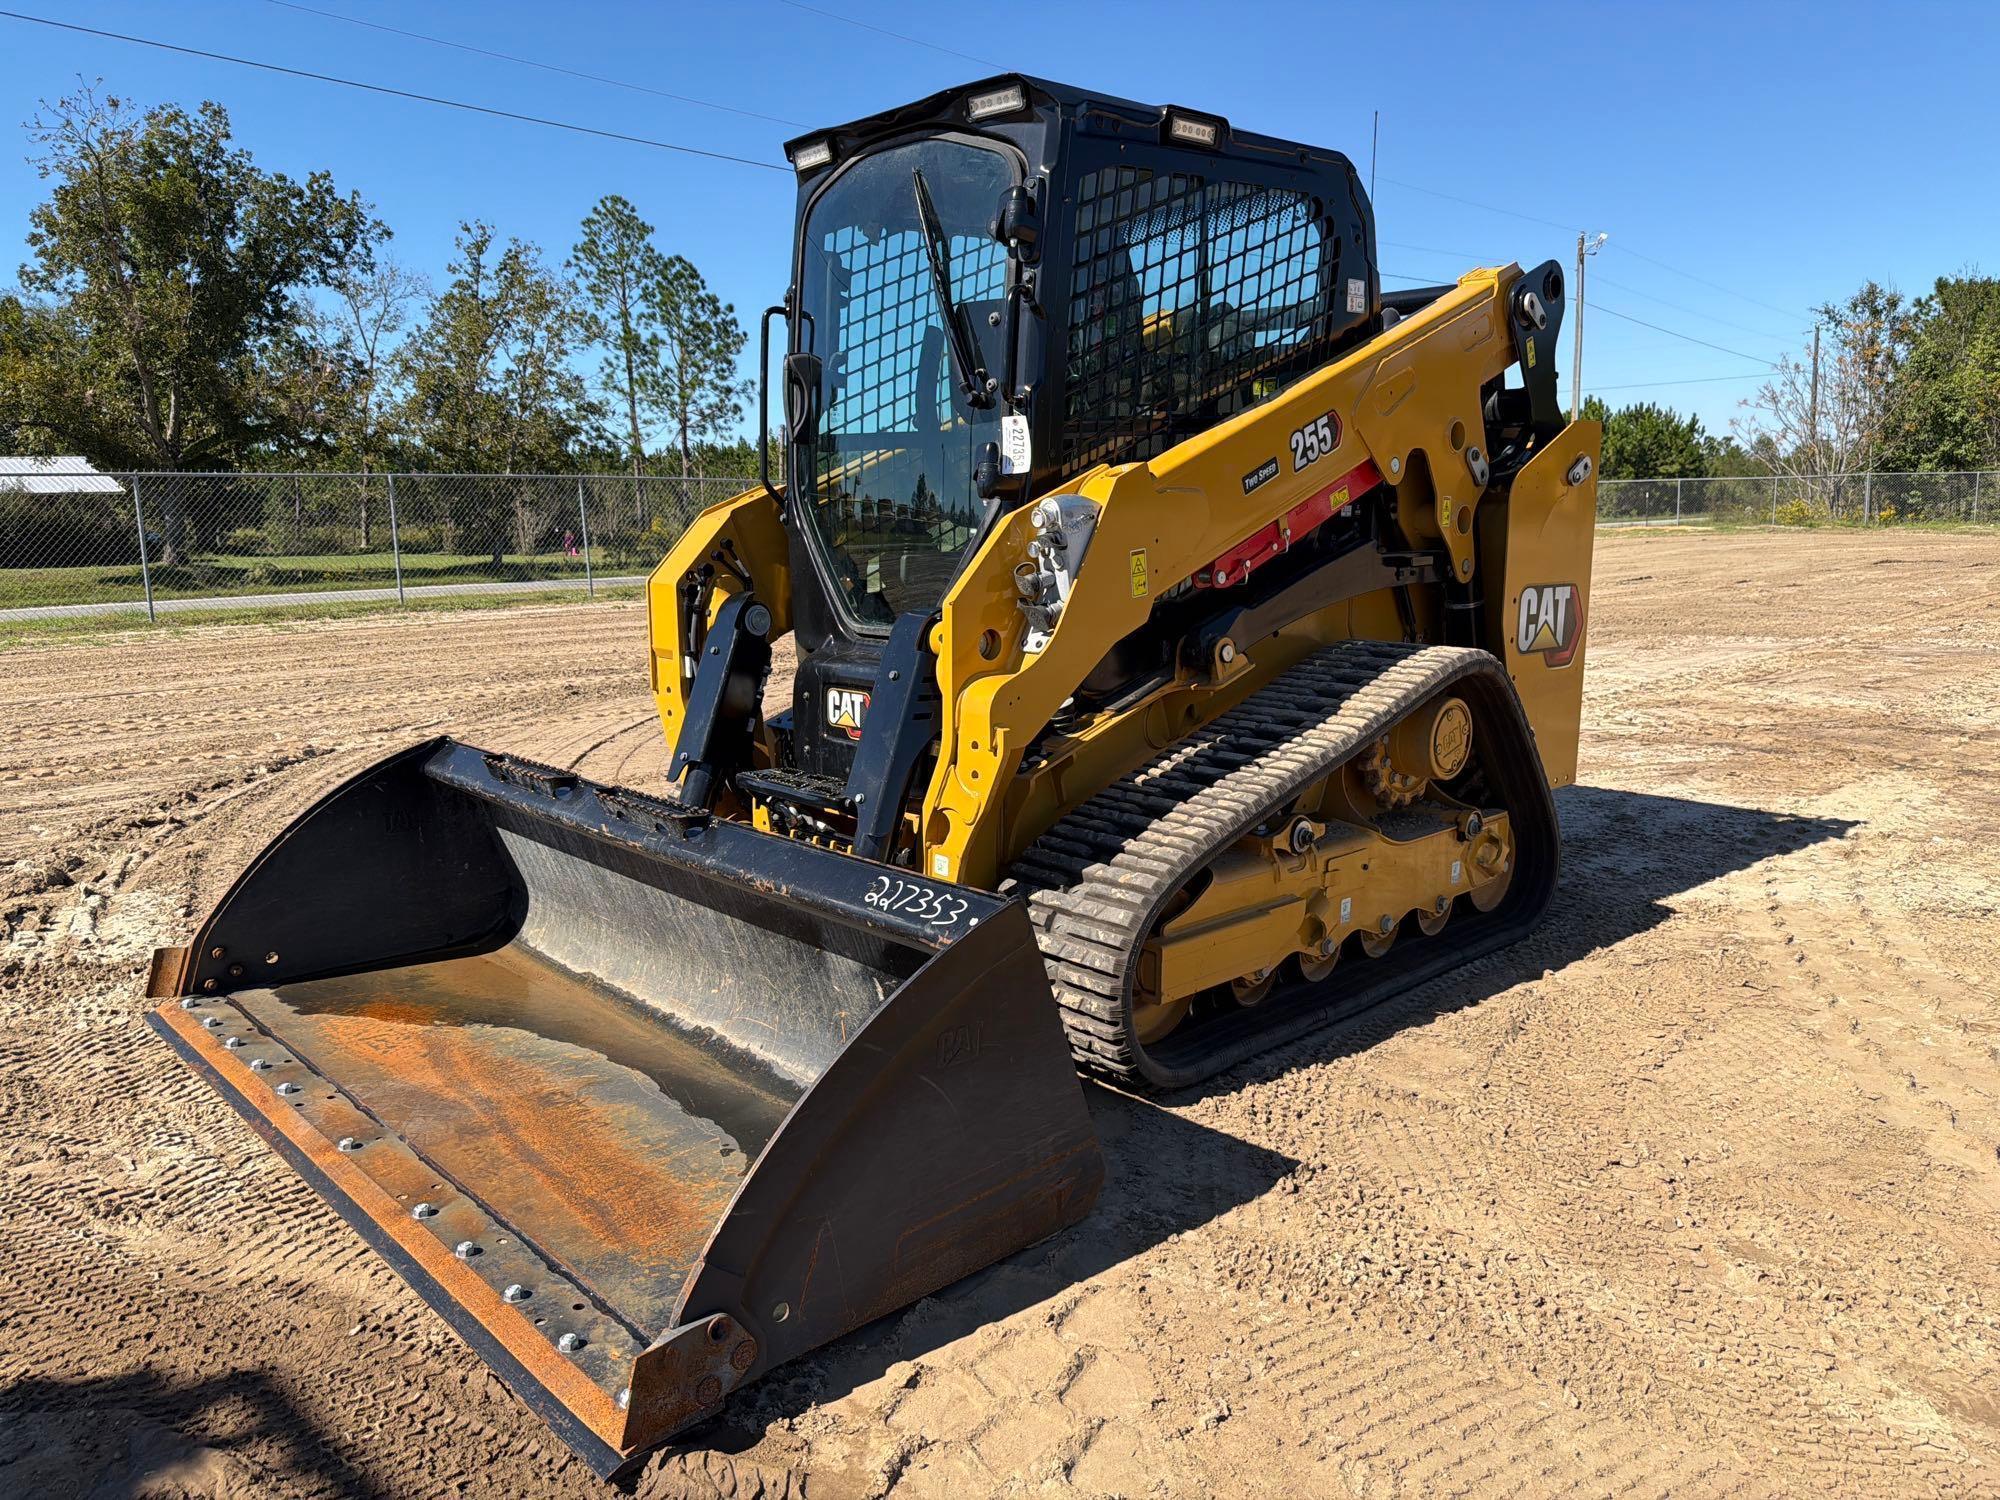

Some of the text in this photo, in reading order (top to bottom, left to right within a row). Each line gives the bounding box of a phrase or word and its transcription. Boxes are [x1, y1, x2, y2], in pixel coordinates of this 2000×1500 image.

[1291, 415, 1332, 470] 255
[1518, 586, 1571, 652] CAT
[828, 690, 864, 728] CAT
